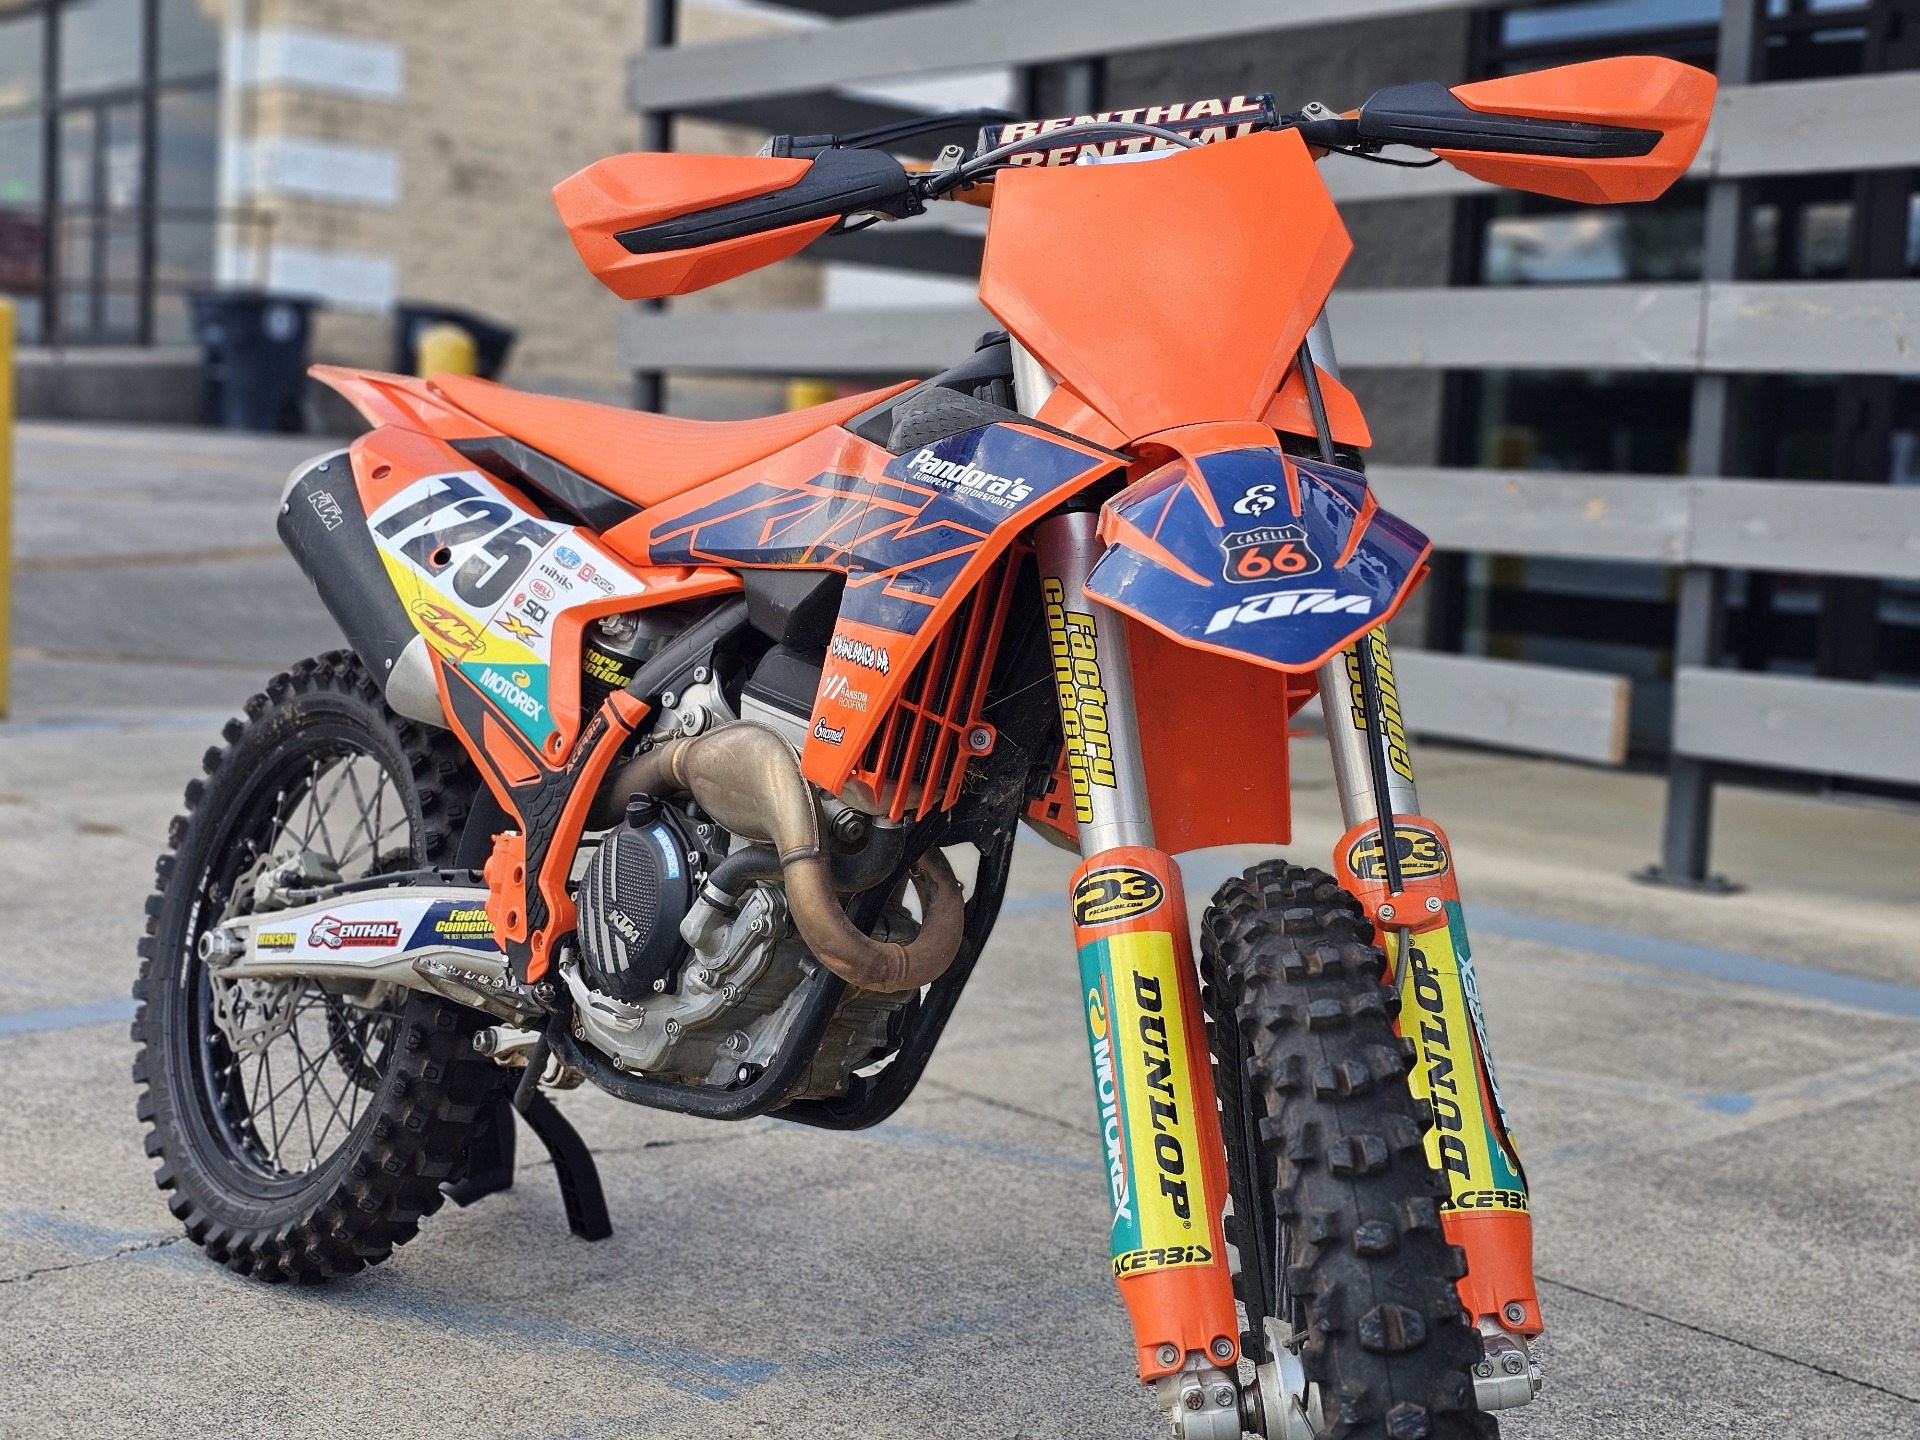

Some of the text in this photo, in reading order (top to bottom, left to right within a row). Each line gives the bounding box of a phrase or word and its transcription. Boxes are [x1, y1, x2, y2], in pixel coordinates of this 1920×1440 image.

[906, 449, 1034, 502] Pandora's
[913, 472, 1018, 509] EUROPEAN MOTORSPORTS
[307, 490, 343, 531] KTM
[1236, 530, 1292, 545] CASELLI
[539, 564, 573, 590] nihilo
[1237, 543, 1307, 578] 66
[533, 581, 551, 597] BELL
[591, 574, 615, 594] OGIO
[412, 601, 486, 652] FMF
[1204, 589, 1372, 635] KTM
[479, 667, 544, 722] MOTOREX
[838, 697, 867, 712] ROOFING
[840, 687, 868, 702] RANSOM
[1067, 610, 1117, 789] Factory
[659, 836, 680, 874] MOTOREX
[448, 909, 488, 921] Facto
[1076, 875, 1157, 926] P3
[435, 920, 496, 933] Connecti
[608, 909, 641, 943] KTM
[1408, 947, 1471, 1181] DUNLOP
[1133, 969, 1190, 1220] DUNLOP
